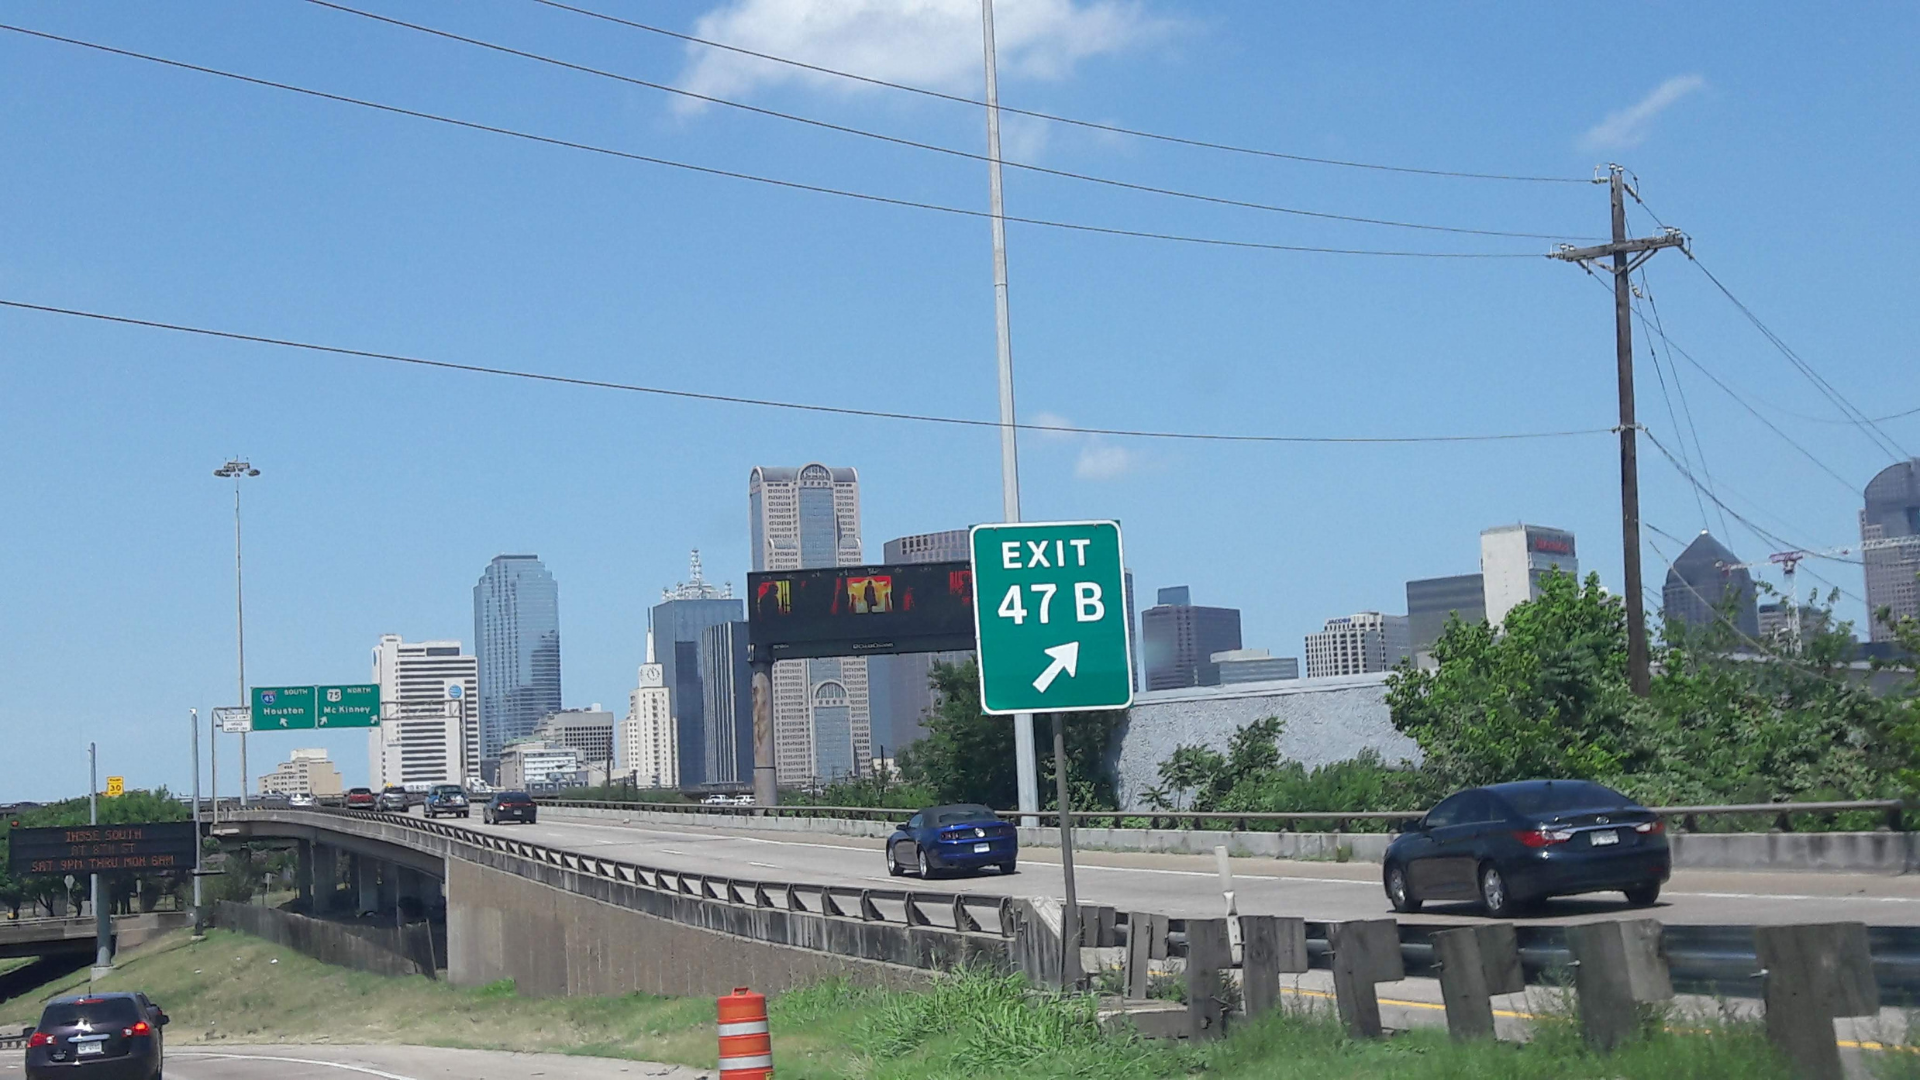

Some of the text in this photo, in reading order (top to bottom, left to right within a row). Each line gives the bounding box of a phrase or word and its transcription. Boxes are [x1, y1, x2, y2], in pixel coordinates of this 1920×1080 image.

[1002, 539, 1091, 569] EXIT
[997, 581, 1105, 625] 47 B
[328, 690, 340, 700] 75
[263, 707, 304, 716] Houston
[105, 829, 142, 841] SOUTH
[71, 844, 86, 856] AT
[121, 842, 136, 854] ST
[31, 855, 175, 872] SAT 9PM THRU MON 6AM
